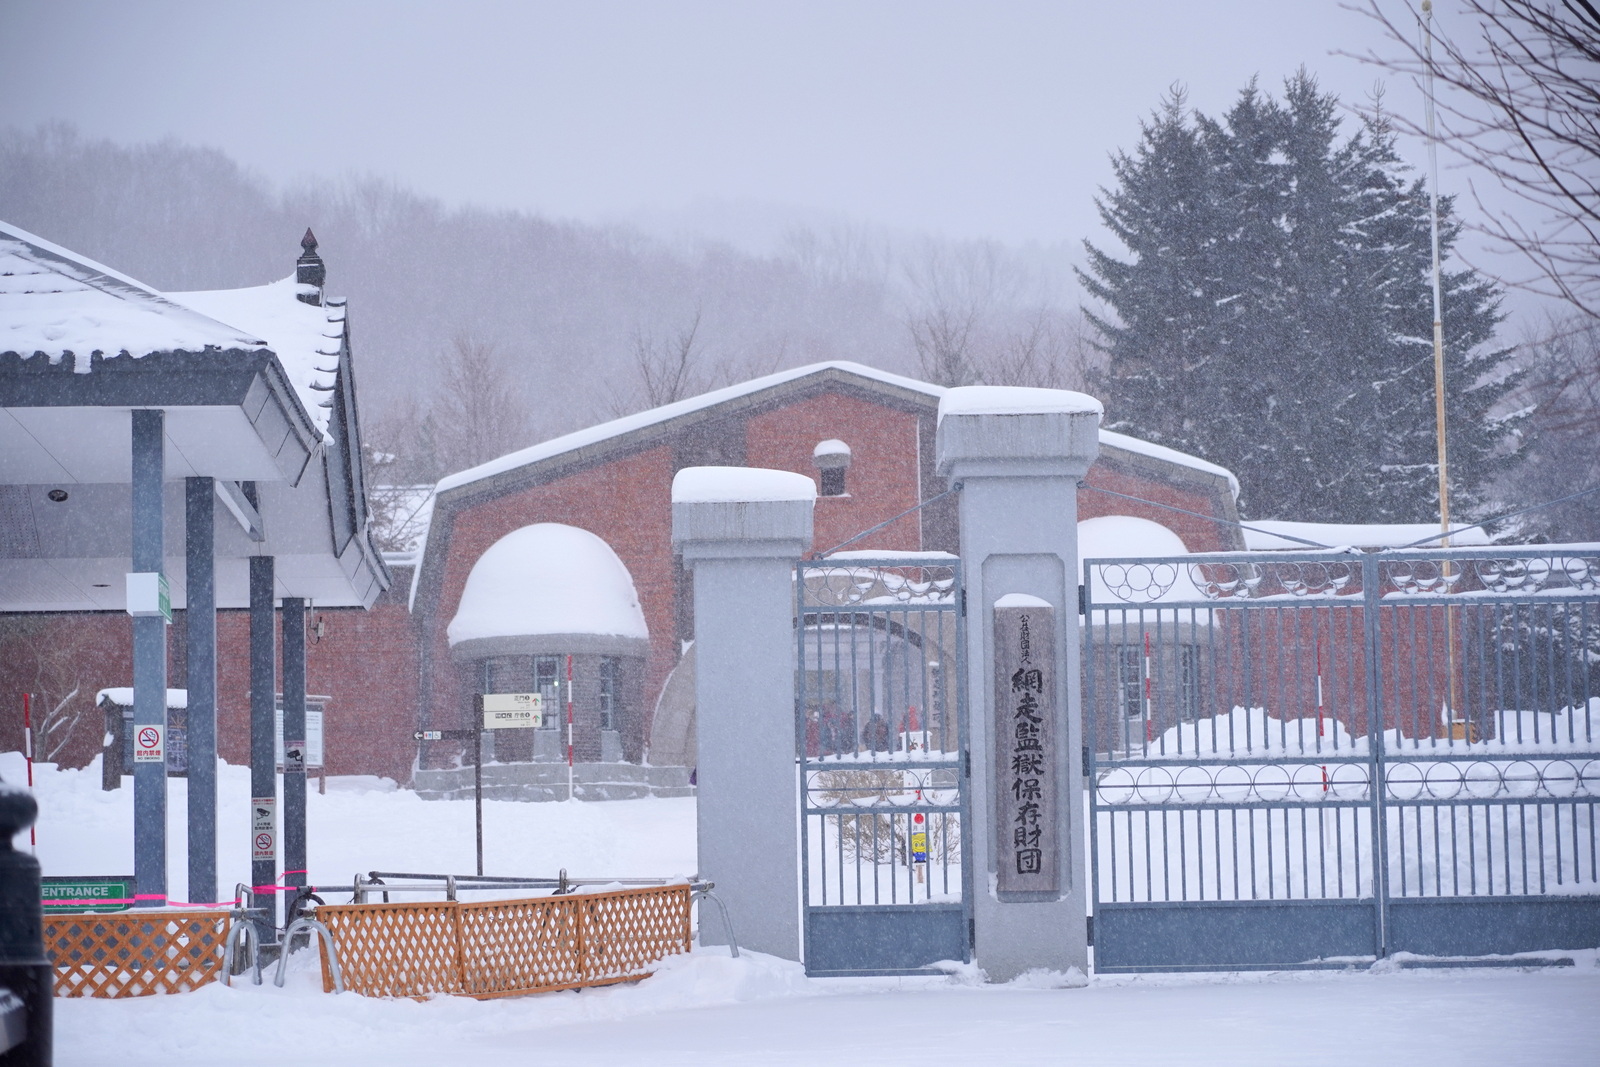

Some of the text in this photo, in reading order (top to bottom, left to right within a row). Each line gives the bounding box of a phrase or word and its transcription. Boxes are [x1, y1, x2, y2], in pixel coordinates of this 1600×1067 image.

[1011, 668, 1044, 875] 網走監獄保存財団
[41, 887, 109, 896] ENTRANCE
